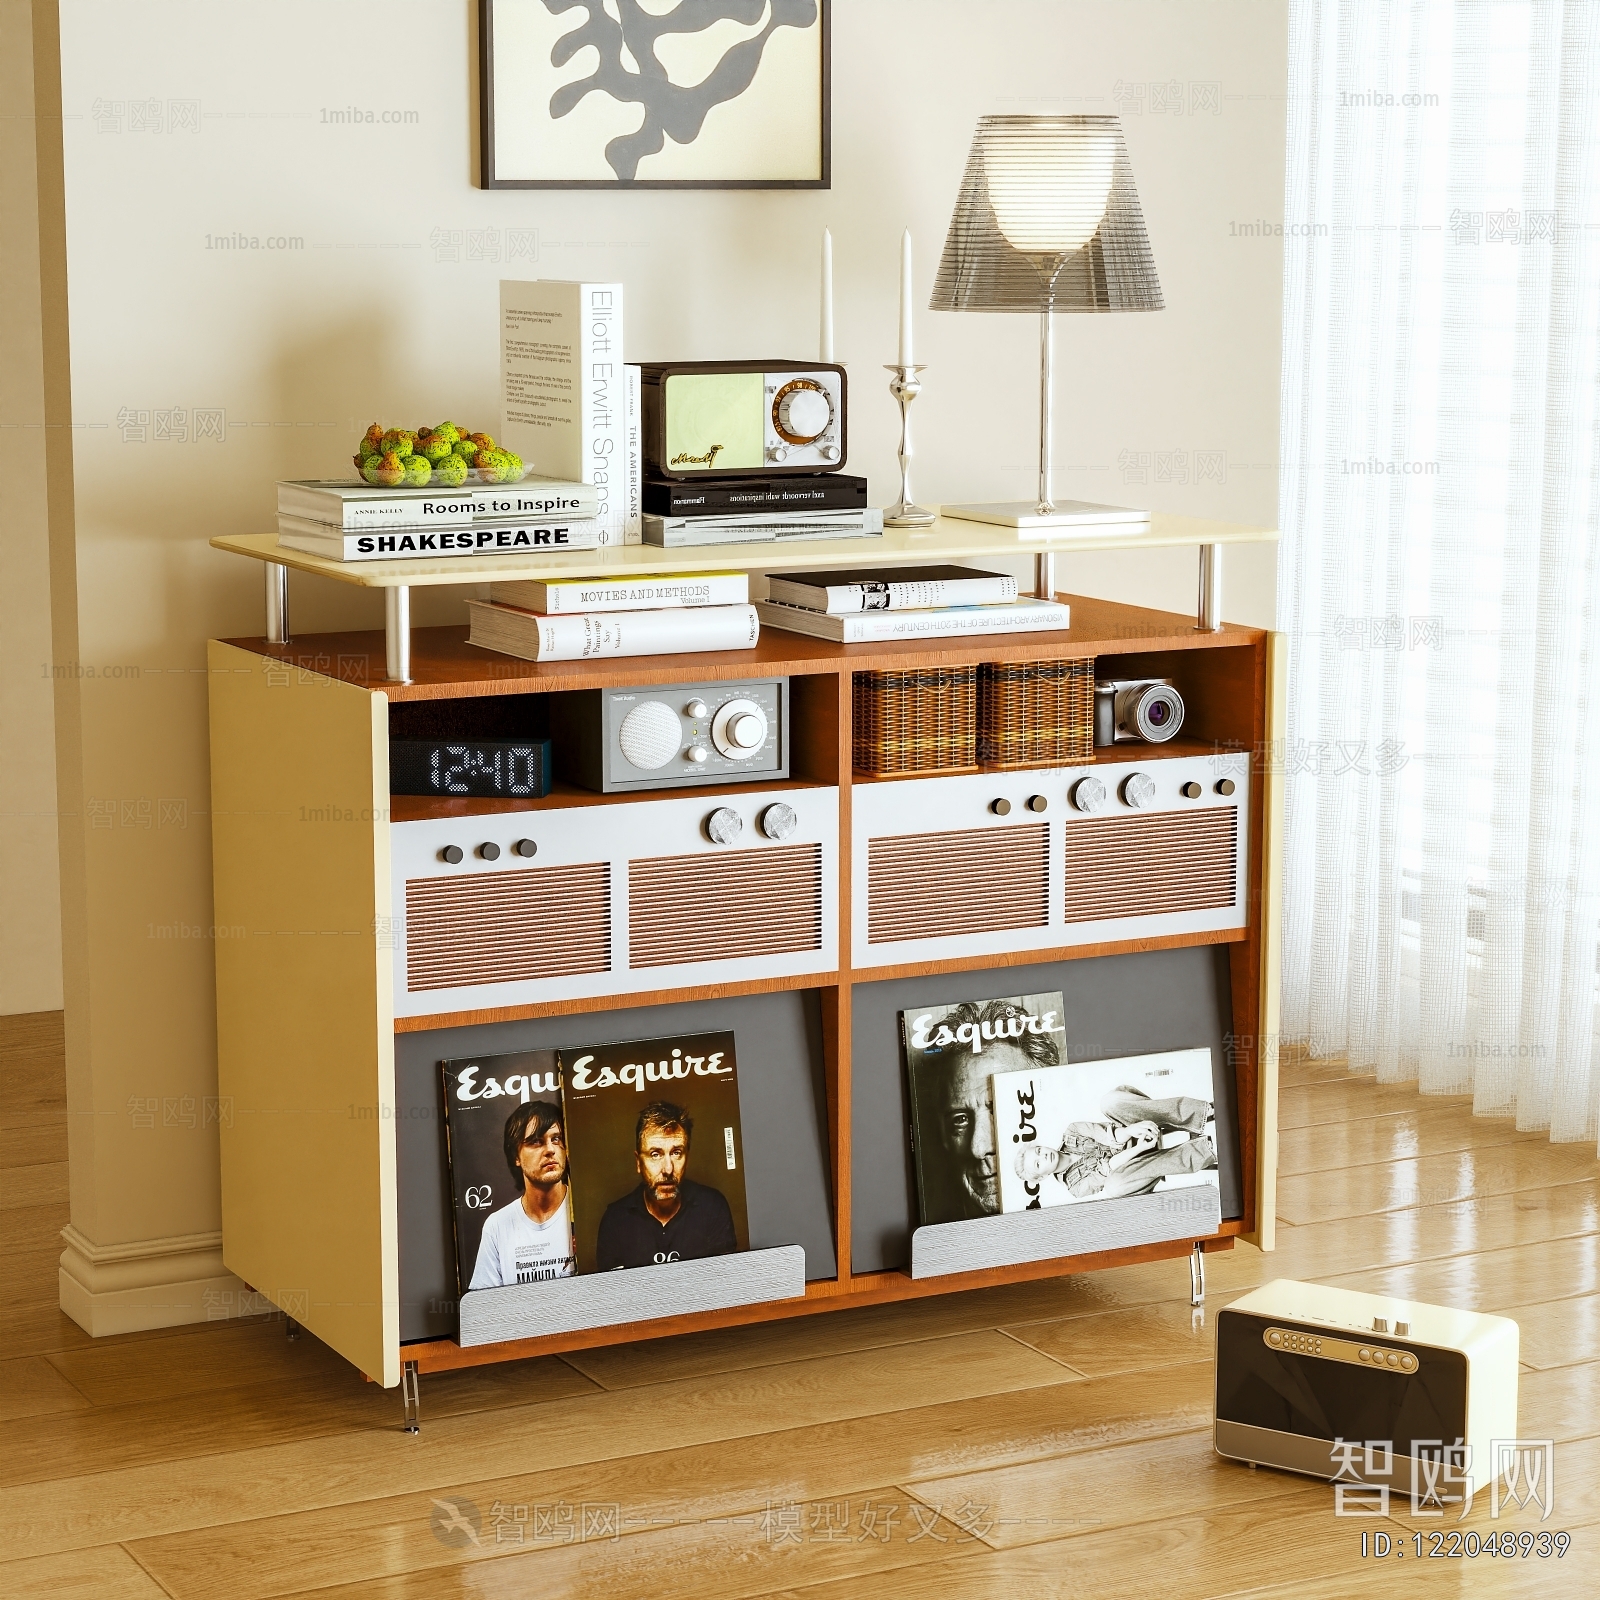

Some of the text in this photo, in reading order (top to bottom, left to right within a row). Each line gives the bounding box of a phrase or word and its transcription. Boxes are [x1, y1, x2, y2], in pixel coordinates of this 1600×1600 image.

[592, 291, 612, 353] Elliott
[592, 363, 613, 429] Erwitt
[629, 426, 638, 518] THE AMERICANS
[423, 497, 580, 514] Rooms to Inspire
[357, 527, 569, 553] SHAKESPEARE
[580, 585, 711, 603] MOVIES AND METHODS
[748, 614, 756, 642] TASCHEN
[892, 621, 930, 632] CENTURY
[930, 620, 952, 630] 20TH
[952, 619, 967, 629] THE
[967, 618, 978, 628] OF
[978, 615, 1030, 627] ARCHITECTURE
[1030, 613, 1064, 624] VISIONARY
[582, 638, 592, 657] What
[592, 620, 602, 653] Paintings
[603, 630, 612, 643] Say
[431, 746, 534, 794] 12:40
[911, 1010, 1065, 1054] Esquire
[571, 1048, 733, 1092] Esquire
[464, 1184, 493, 1210] 62
